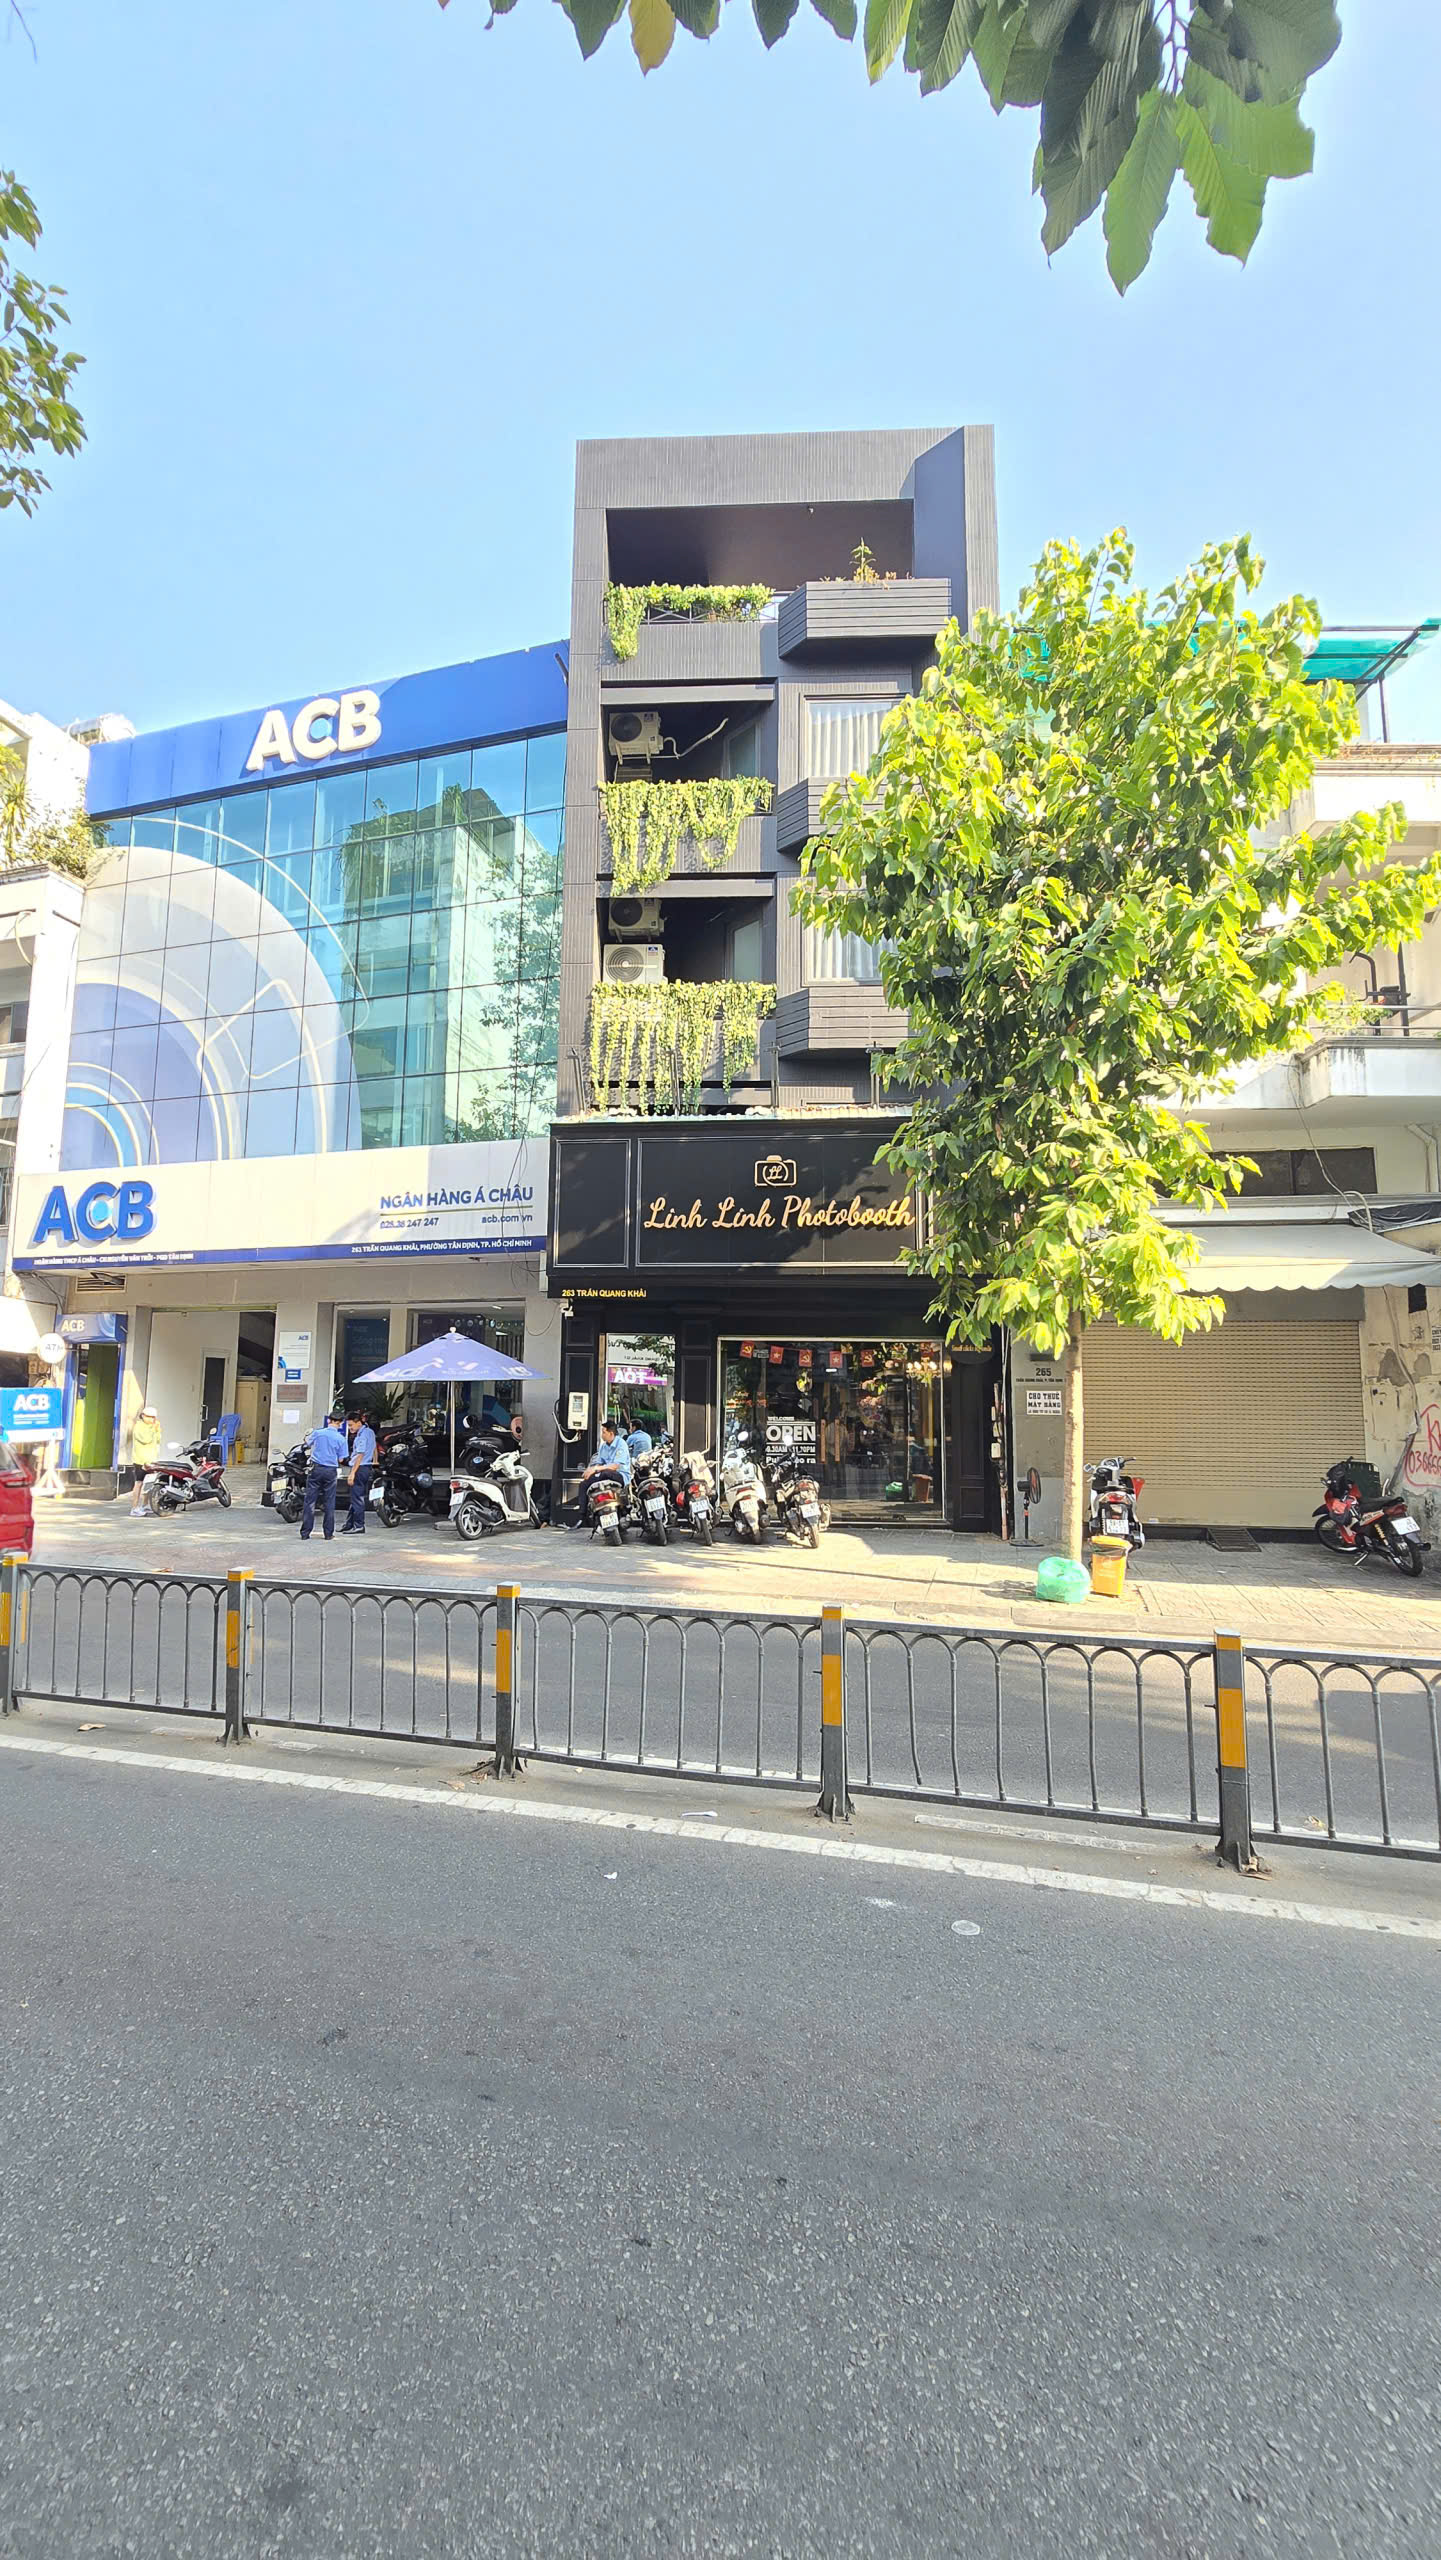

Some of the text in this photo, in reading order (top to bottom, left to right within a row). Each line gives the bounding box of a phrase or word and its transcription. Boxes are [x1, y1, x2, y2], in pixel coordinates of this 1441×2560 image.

[246, 690, 382, 771] ACB
[380, 1184, 533, 1209] NGÂN HÀNG Á CHÂU
[32, 1180, 154, 1243] ACB
[481, 1214, 533, 1223] acb.comvn
[644, 1195, 916, 1229] Linh Linh Photobooth
[423, 1217, 439, 1227] 247
[599, 1289, 626, 1297] QUANG
[61, 1319, 85, 1332] ACB
[1036, 1367, 1052, 1377] 265
[13, 1393, 50, 1411] ACB
[765, 1425, 816, 1442] OPEN
